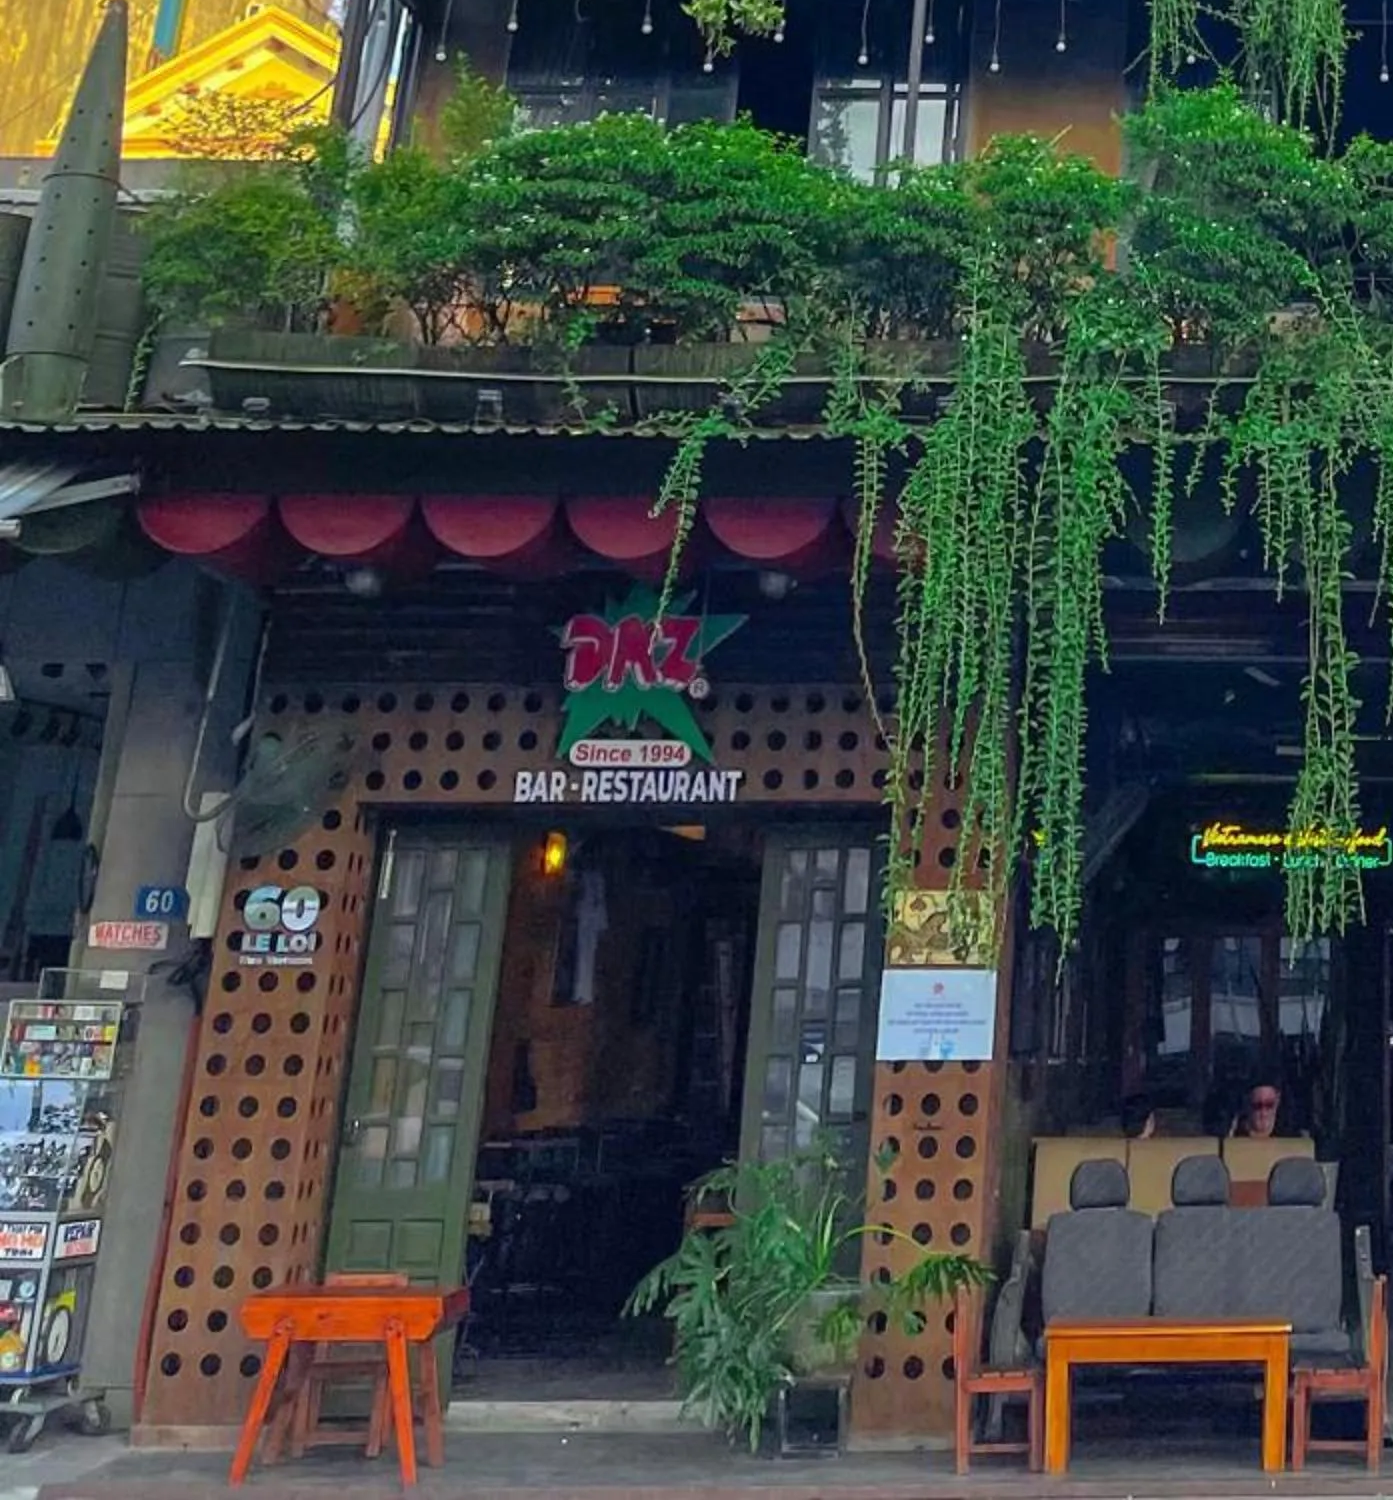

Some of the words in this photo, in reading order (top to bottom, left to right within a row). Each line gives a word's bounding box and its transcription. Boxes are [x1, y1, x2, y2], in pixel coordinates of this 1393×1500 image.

[575, 743, 631, 762] Since
[641, 744, 686, 763] 1994
[1206, 851, 1271, 867] Breakfast
[145, 889, 174, 913] 60
[243, 885, 321, 932] 60
[240, 933, 271, 952] LE
